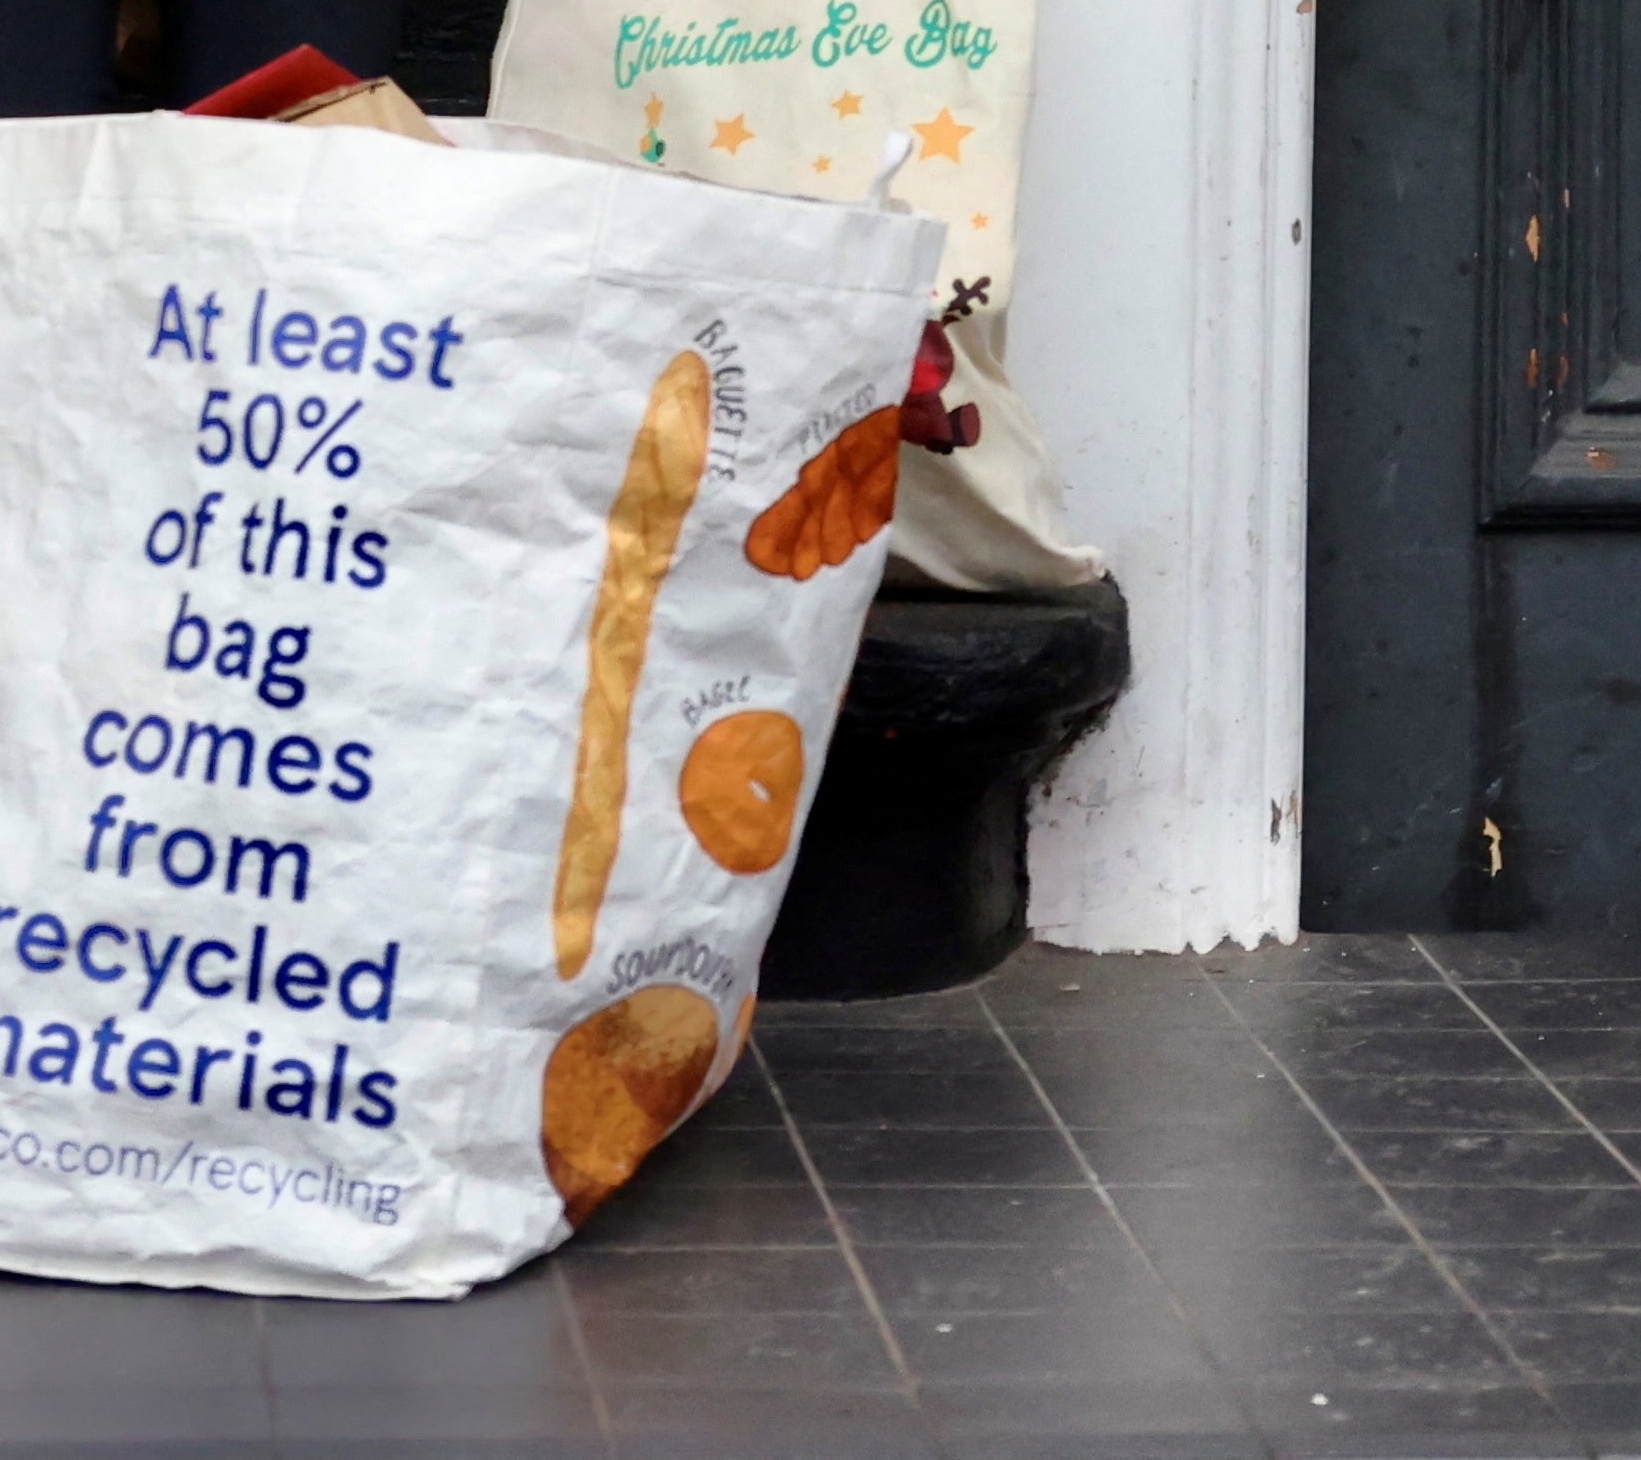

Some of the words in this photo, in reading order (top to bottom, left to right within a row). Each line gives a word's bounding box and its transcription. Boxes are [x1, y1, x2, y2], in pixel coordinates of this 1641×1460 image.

[614, 14, 801, 89] Christmas
[148, 284, 223, 362] At
[248, 288, 464, 389] least
[196, 389, 363, 479] 50%
[693, 319, 748, 482] BAGUETTE
[145, 492, 224, 569] of
[241, 498, 390, 589] this
[164, 592, 312, 709] bag
[82, 710, 374, 801] comes
[84, 795, 311, 902] from
